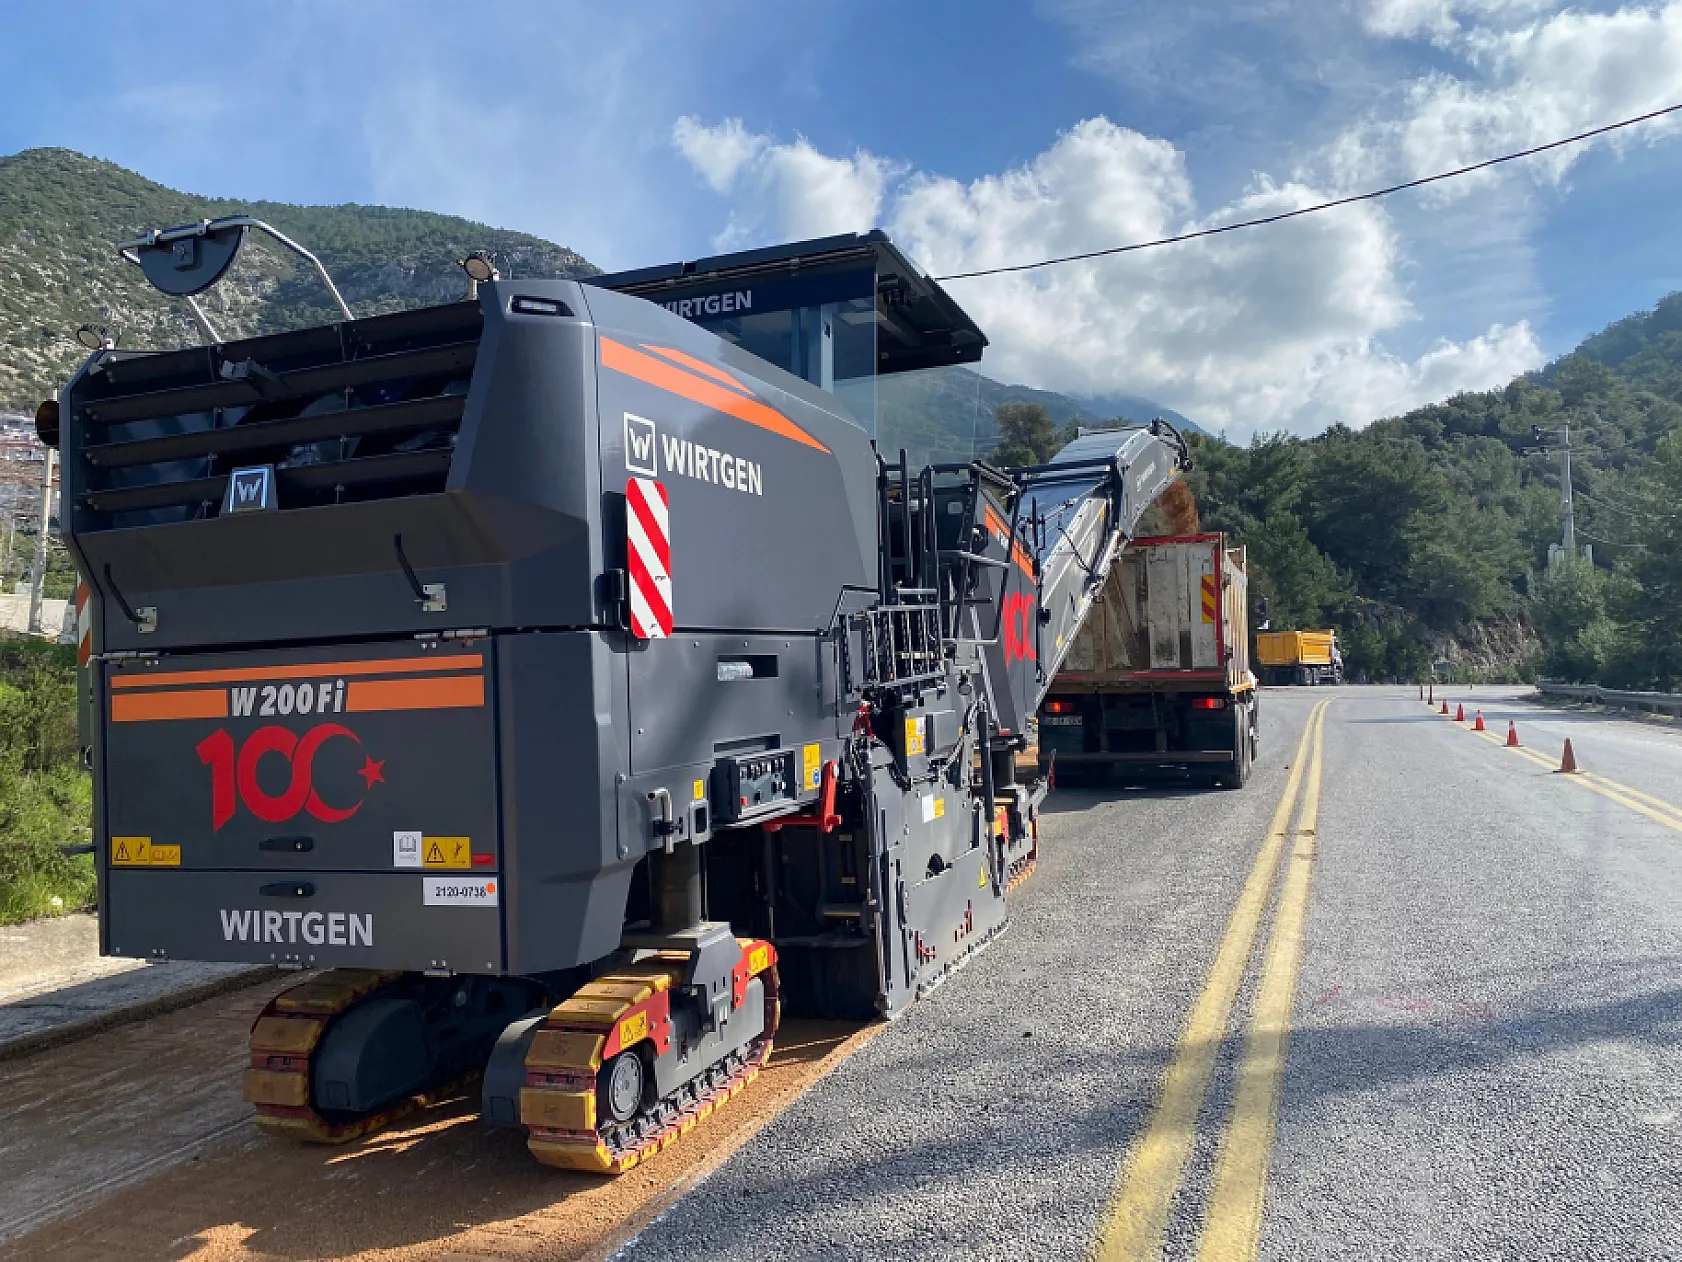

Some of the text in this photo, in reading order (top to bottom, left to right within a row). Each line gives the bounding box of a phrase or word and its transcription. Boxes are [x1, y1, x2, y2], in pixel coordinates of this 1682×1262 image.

[662, 290, 752, 317] IRTGEN
[629, 428, 763, 496] W WIRTGEN
[237, 478, 262, 502] W
[196, 723, 365, 832] 100
[220, 904, 373, 947] WIRTGEN
